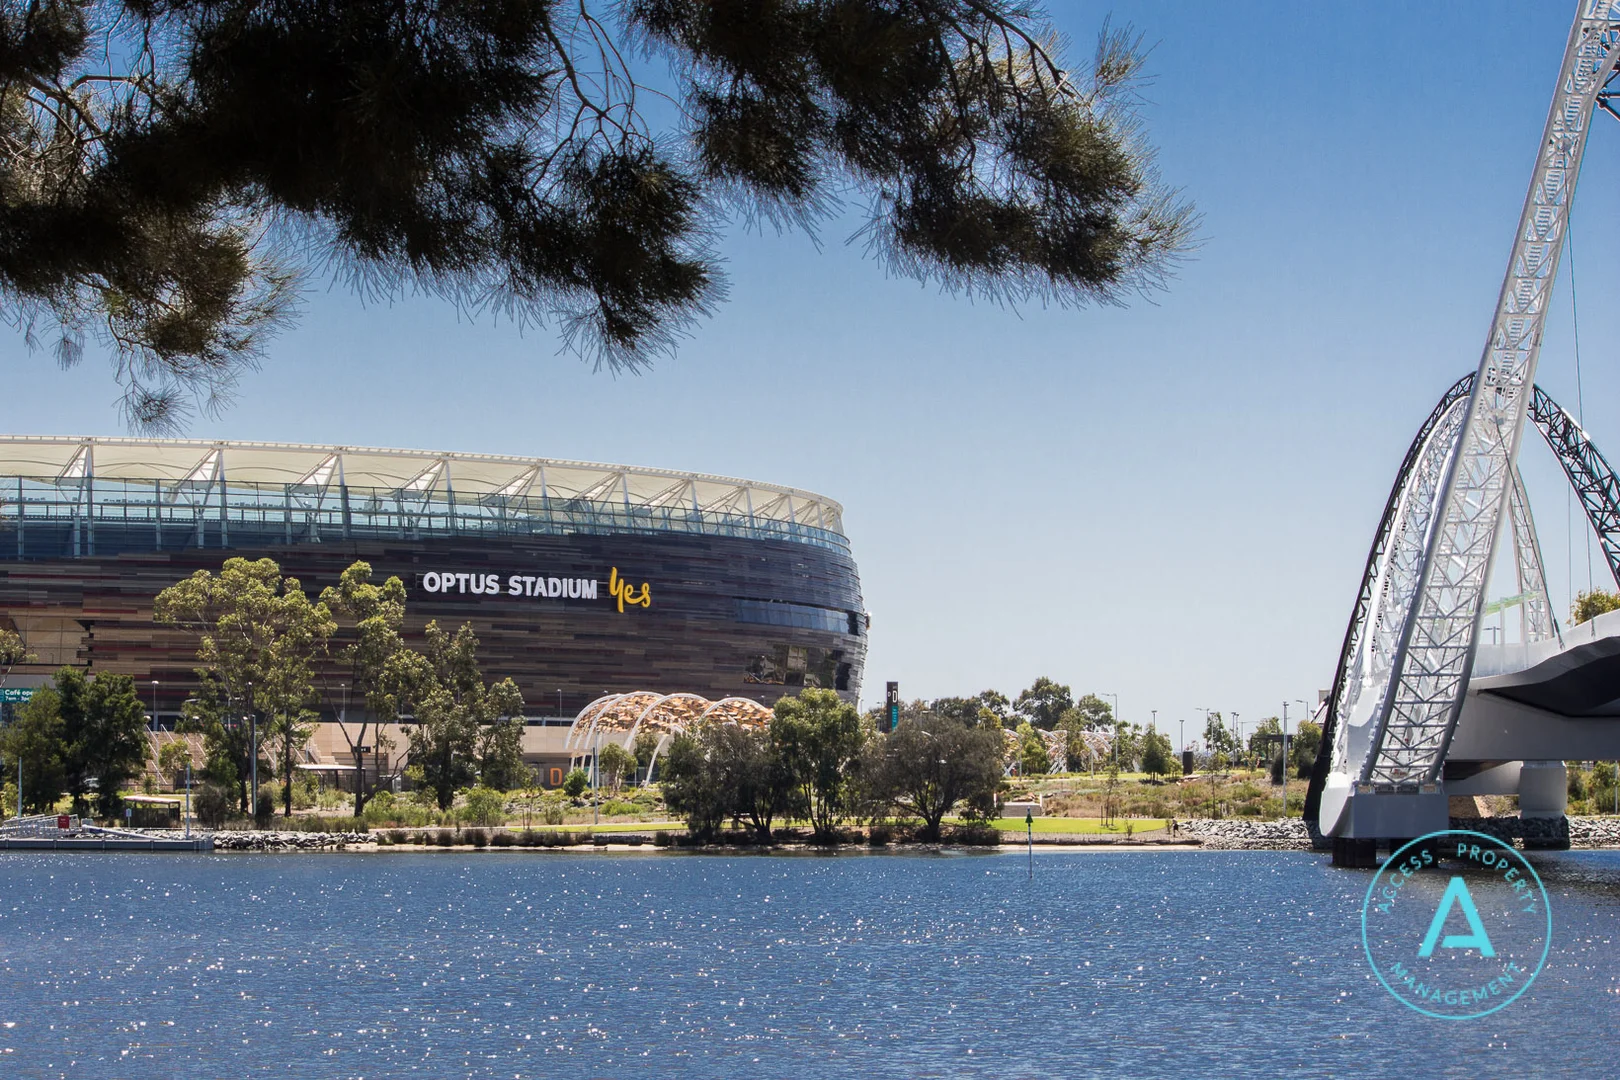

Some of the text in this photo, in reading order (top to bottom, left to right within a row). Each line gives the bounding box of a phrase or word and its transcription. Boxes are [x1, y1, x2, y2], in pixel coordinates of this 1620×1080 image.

[423, 571, 598, 600] OPTUS STADIUM
[892, 690, 897, 703] D
[550, 768, 562, 786] D
